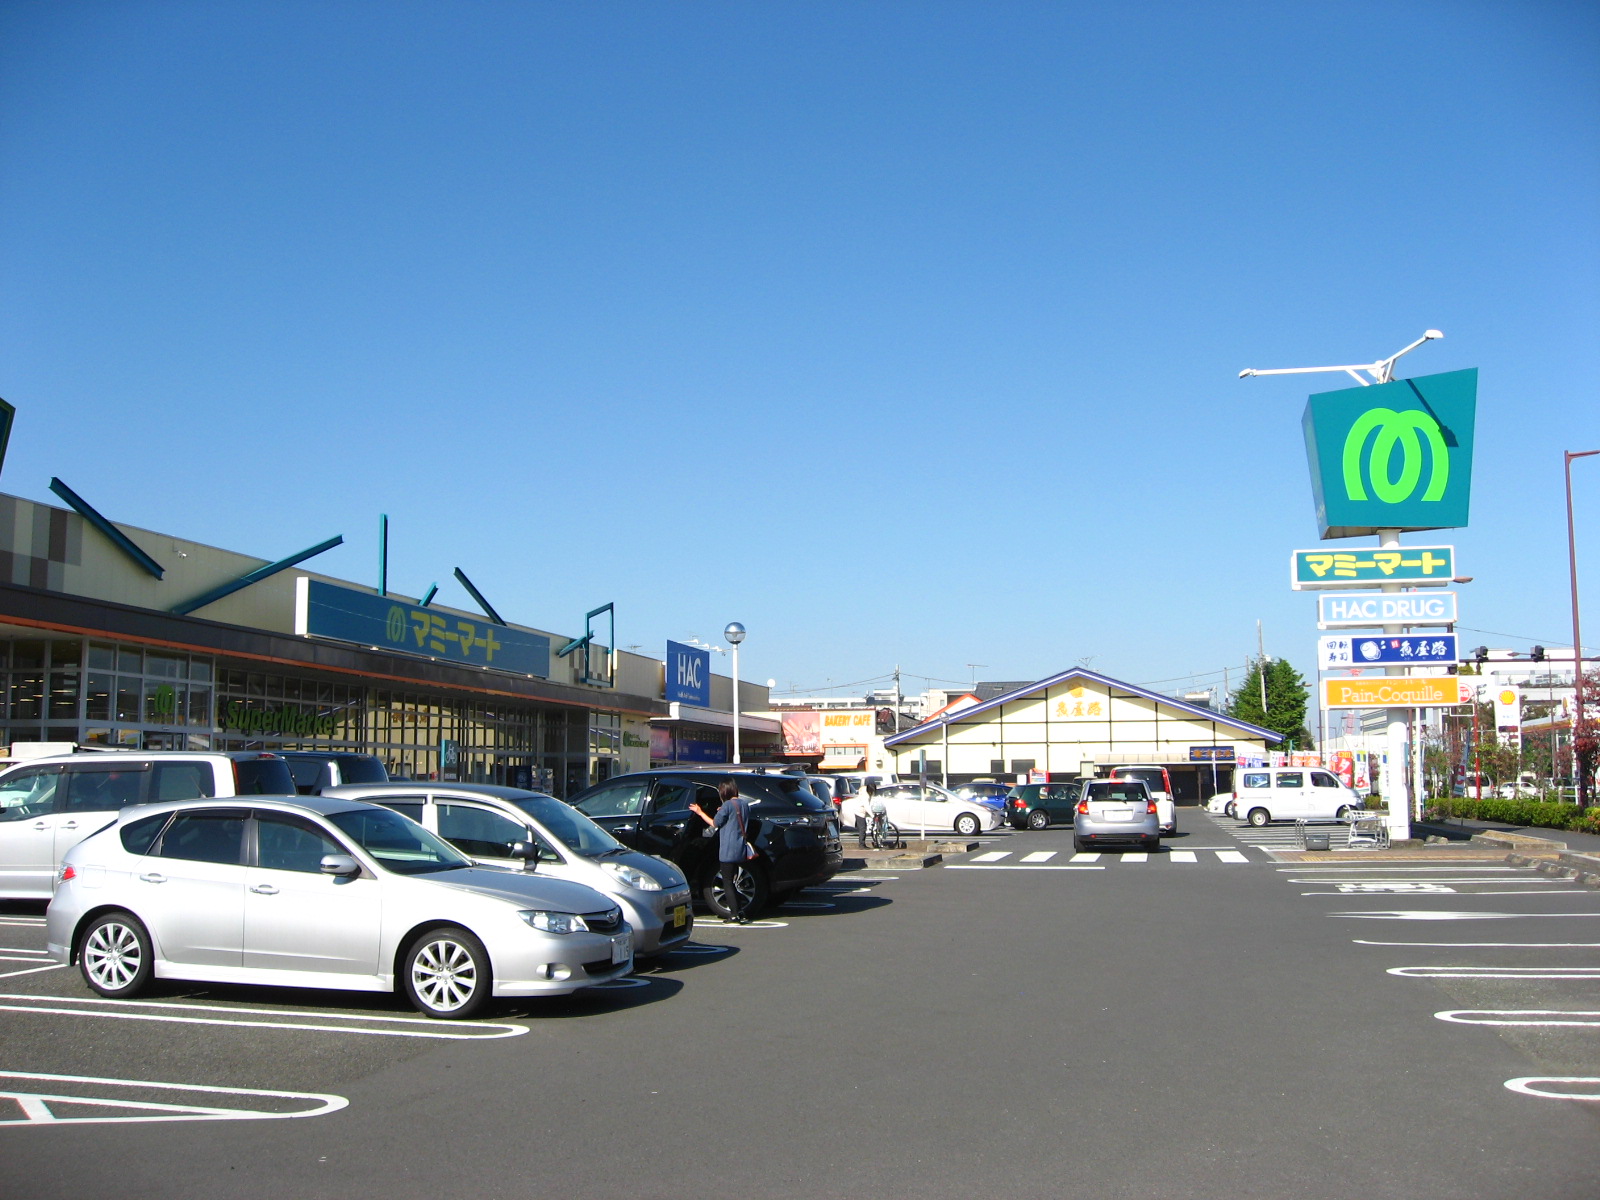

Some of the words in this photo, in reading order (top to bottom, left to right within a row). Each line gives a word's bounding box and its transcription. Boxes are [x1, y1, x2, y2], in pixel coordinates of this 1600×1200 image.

[1306, 552, 1446, 577] マミーマート
[1331, 601, 1377, 619] HAC
[1382, 599, 1445, 617] DRUG
[411, 610, 501, 661] マミーマート
[1327, 641, 1348, 649] 回転
[1328, 652, 1348, 661] 寿司
[1400, 640, 1448, 657] 魚屋路
[677, 653, 702, 689] HAC
[1341, 686, 1443, 704] Pain-Coquille
[225, 700, 339, 736] SuperMarket
[825, 715, 851, 727] BAKERY
[853, 714, 872, 726] CAFE
